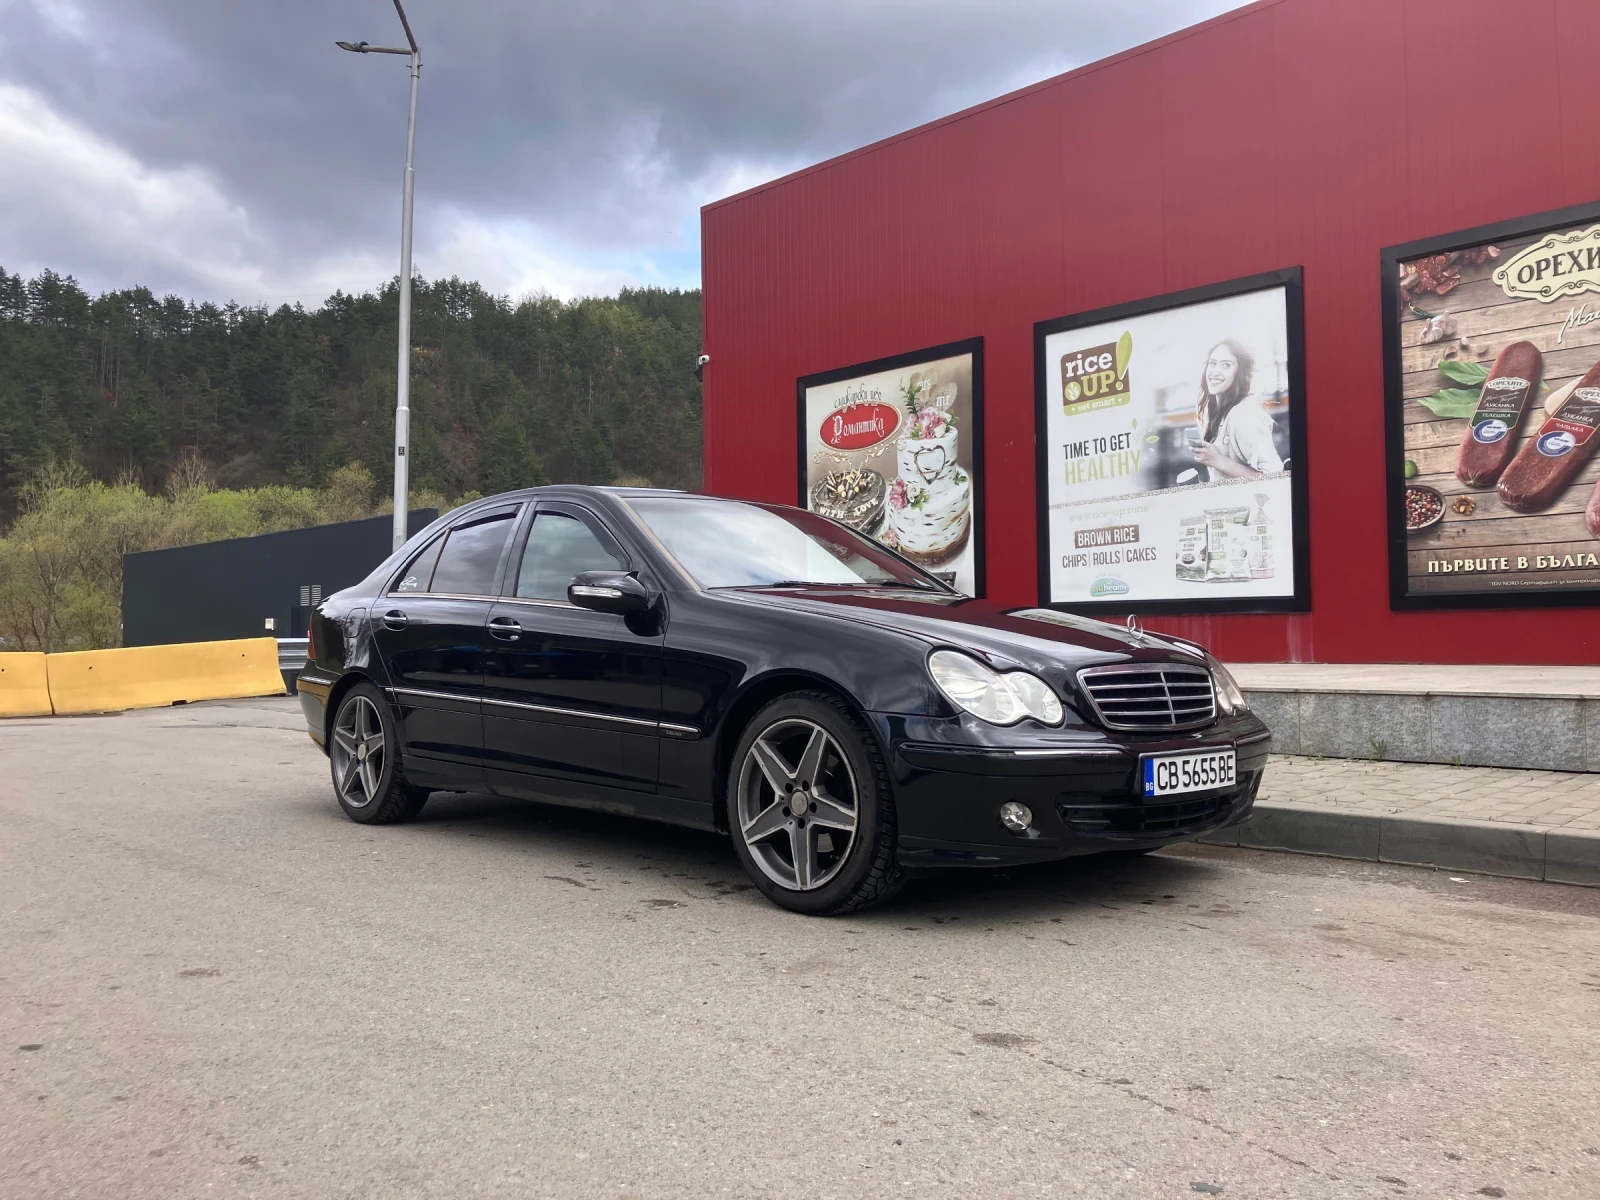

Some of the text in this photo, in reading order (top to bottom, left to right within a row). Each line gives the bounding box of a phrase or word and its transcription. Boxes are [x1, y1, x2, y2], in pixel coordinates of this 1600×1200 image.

[1065, 352, 1113, 378] rice
[1091, 397, 1117, 409] smart
[1063, 432, 1132, 460] TIME TO GET
[1064, 449, 1142, 486] HEALTHY
[819, 507, 845, 519] WITH
[1077, 526, 1136, 547] BROWN RICE
[1062, 546, 1157, 568] CHIPS ROLLS CAKES
[1517, 556, 1529, 570] В
[1536, 553, 1600, 570] БЪЛГА
[1145, 782, 1154, 792] BG
